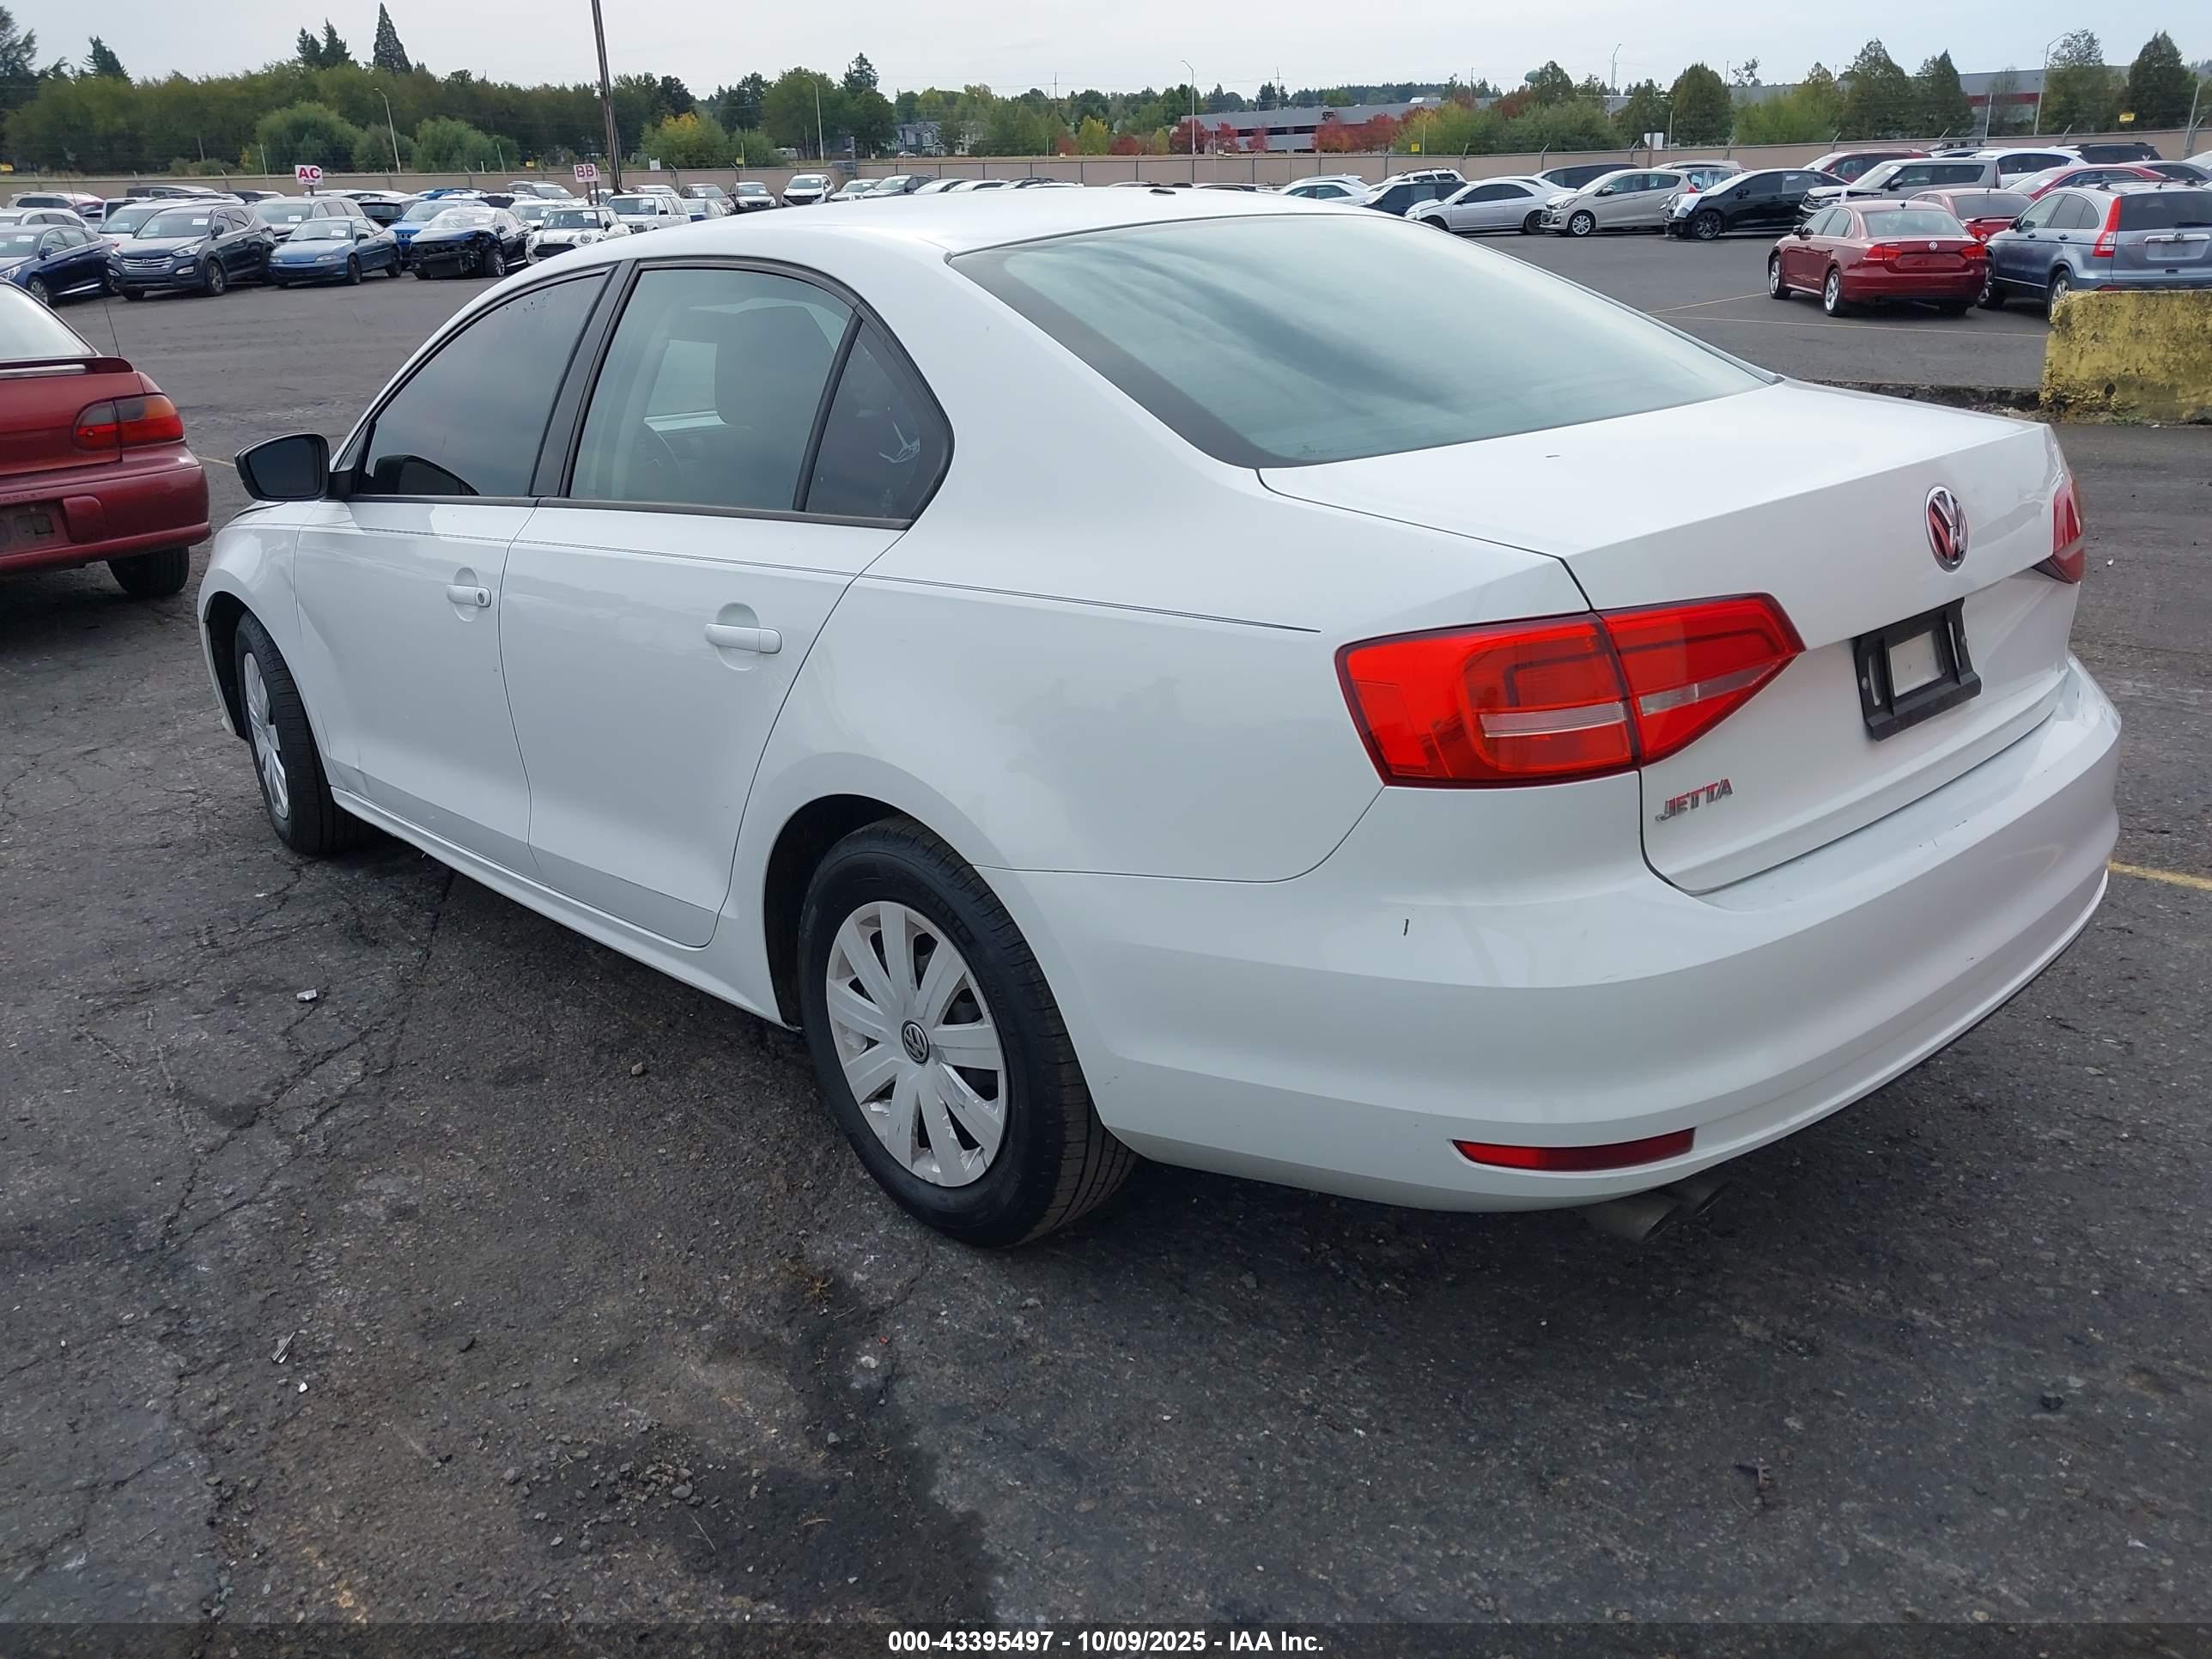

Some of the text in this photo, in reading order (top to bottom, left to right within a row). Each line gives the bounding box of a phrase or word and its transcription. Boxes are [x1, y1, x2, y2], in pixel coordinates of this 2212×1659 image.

[298, 167, 321, 179] AC
[576, 165, 594, 178] BB
[1655, 778, 1734, 822] JETTA
